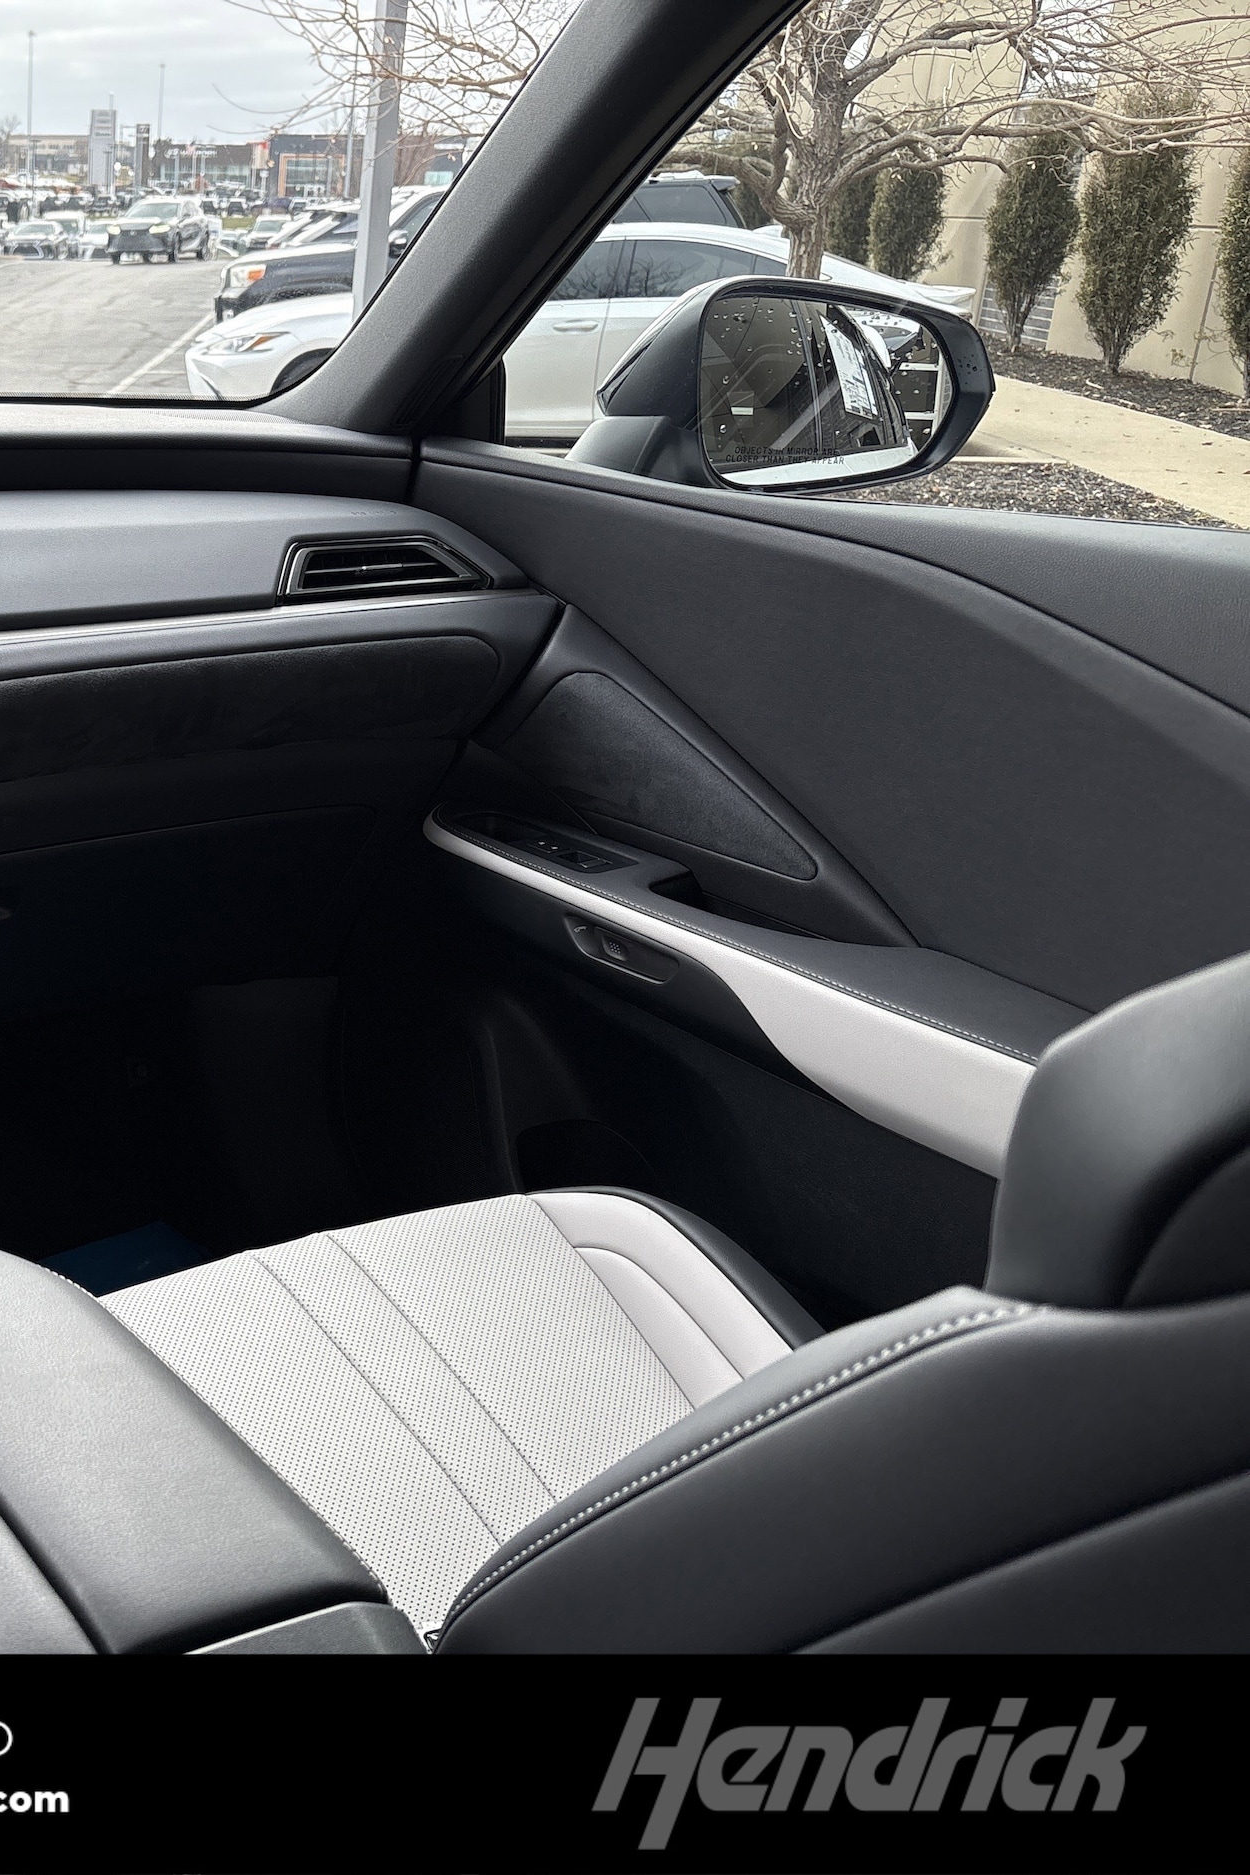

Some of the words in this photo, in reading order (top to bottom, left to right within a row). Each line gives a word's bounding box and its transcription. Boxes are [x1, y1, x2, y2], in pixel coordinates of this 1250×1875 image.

[734, 446, 773, 455] OBJECTS
[776, 448, 784, 456] IN
[787, 447, 819, 455] MIRROR
[726, 454, 760, 463] CLOSER
[762, 455, 784, 464] THAN
